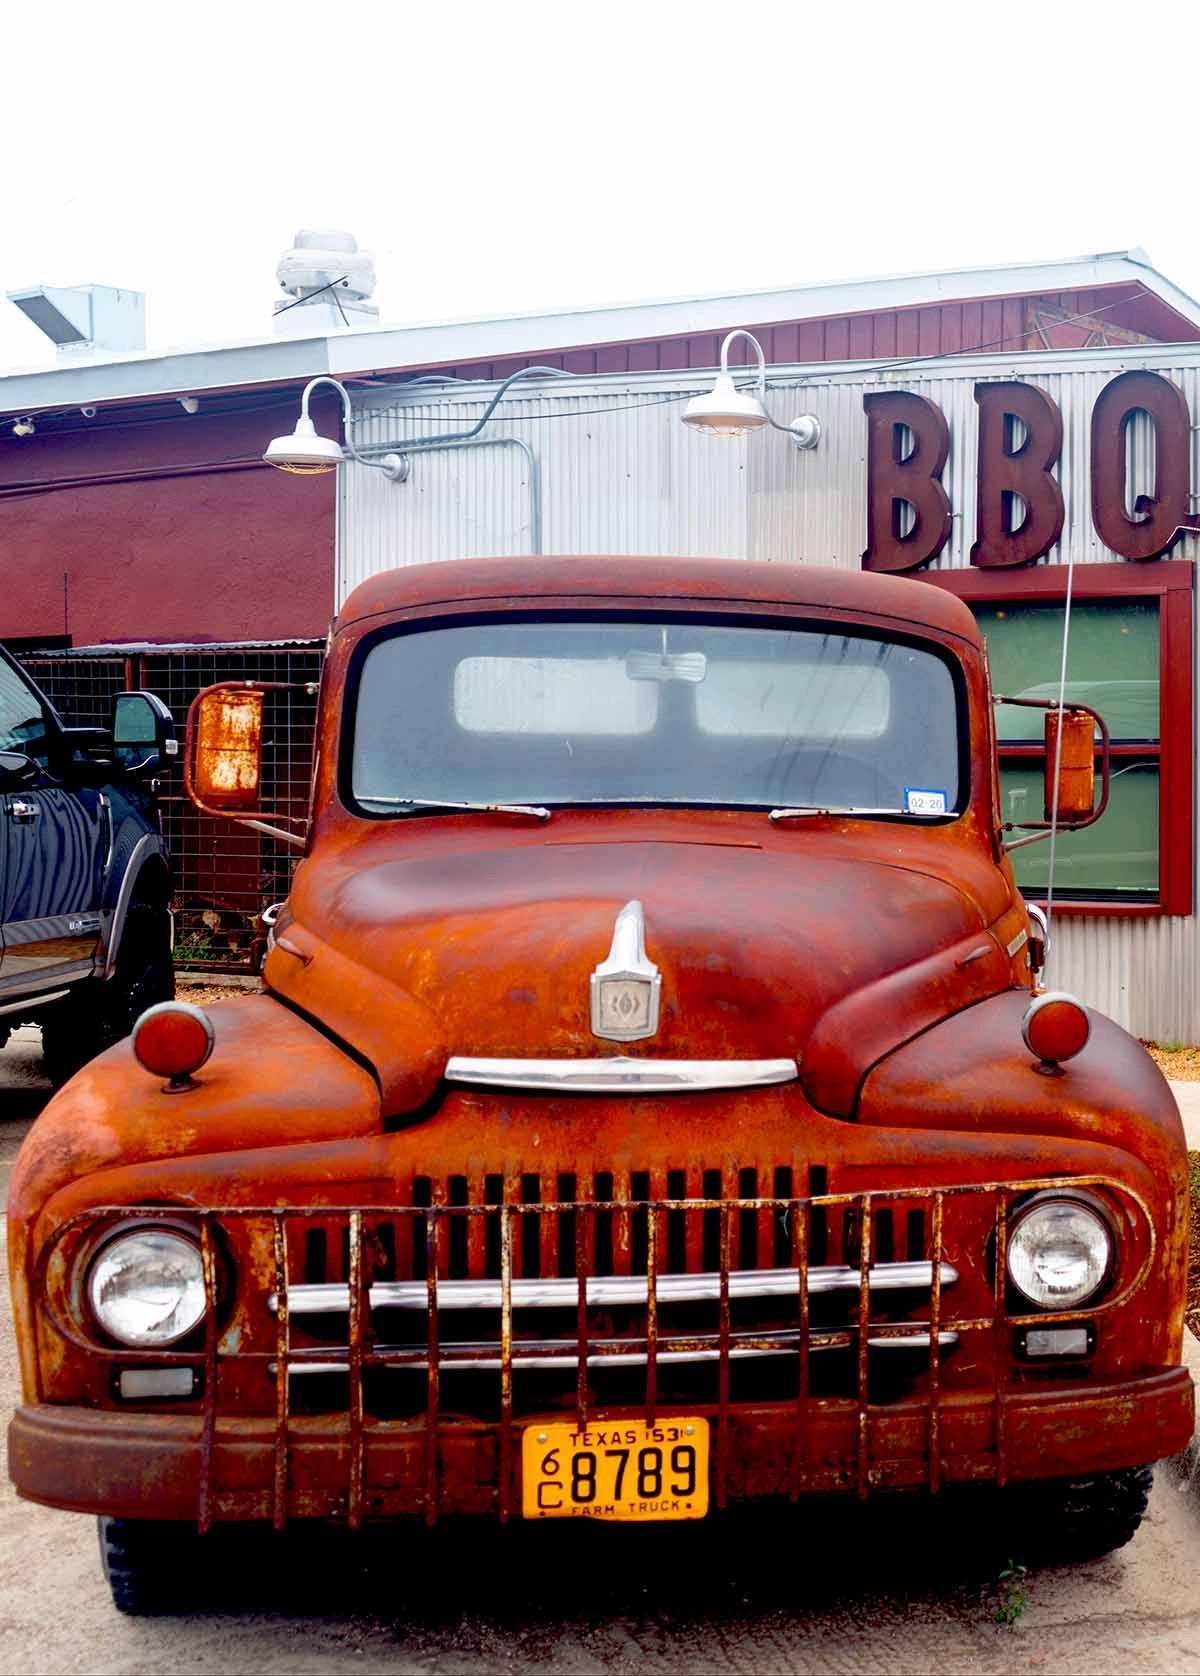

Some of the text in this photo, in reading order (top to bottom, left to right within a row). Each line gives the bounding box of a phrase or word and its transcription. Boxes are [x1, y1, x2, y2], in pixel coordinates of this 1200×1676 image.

[569, 1430, 637, 1447] TEXAS
[541, 1448, 560, 1475] 6
[571, 1445, 696, 1503] 8789
[537, 1481, 563, 1509] C
[572, 1500, 680, 1516] FARM TRUCK
